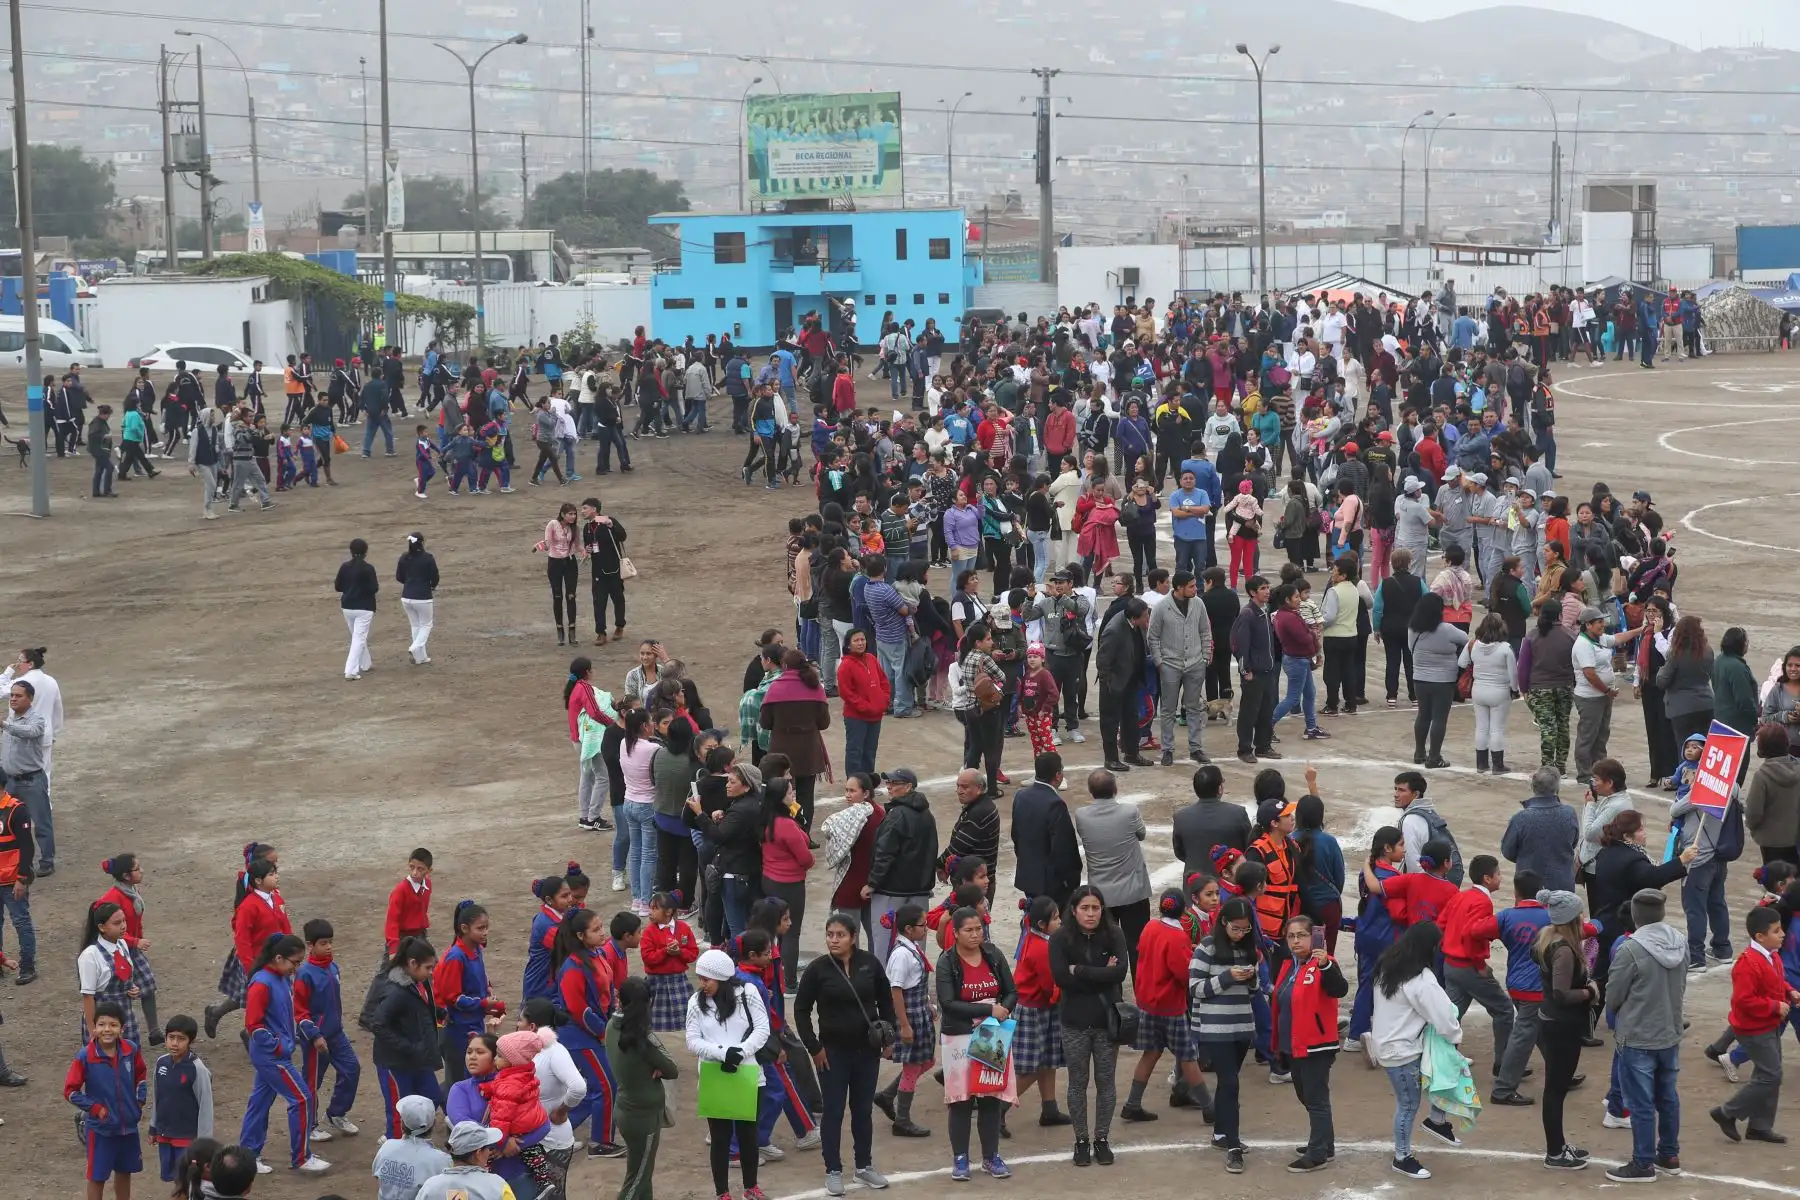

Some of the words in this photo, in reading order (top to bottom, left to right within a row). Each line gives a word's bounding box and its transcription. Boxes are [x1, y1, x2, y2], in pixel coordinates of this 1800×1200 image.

[796, 152, 814, 160] BECA
[816, 151, 852, 160] REGIONAL
[1697, 770, 1729, 798] PRIMARIA
[1303, 966, 1316, 985] S
